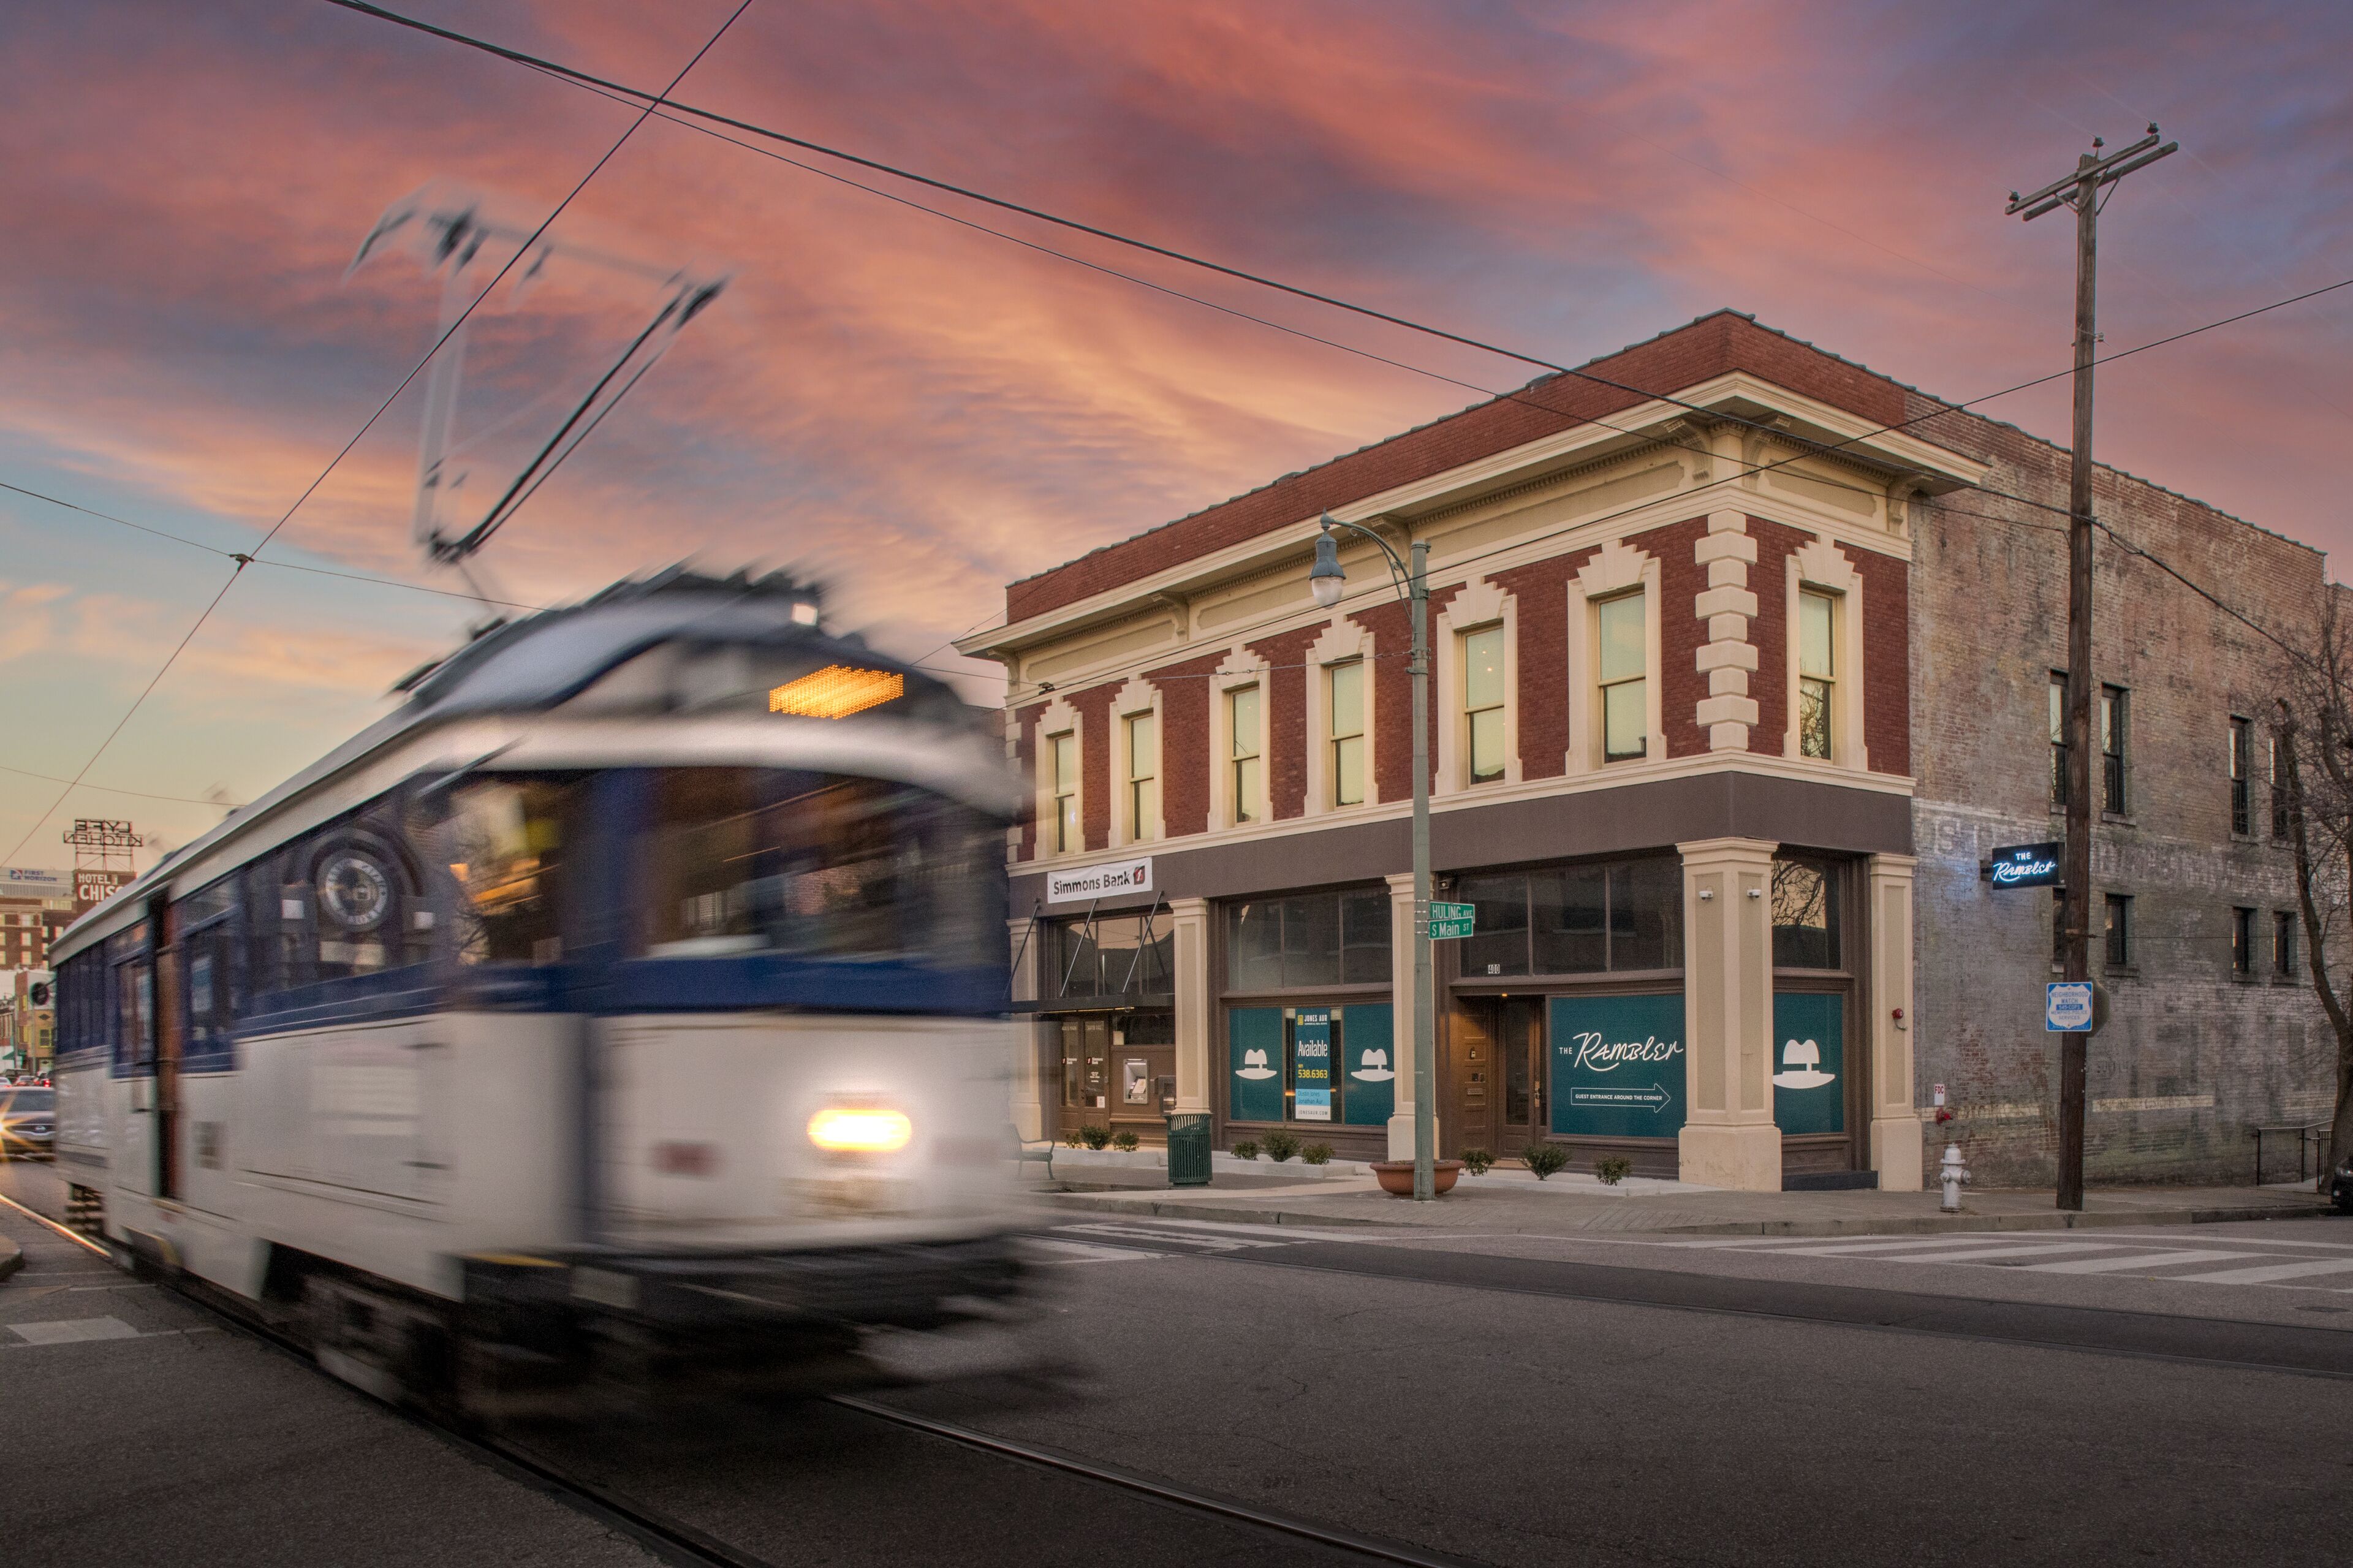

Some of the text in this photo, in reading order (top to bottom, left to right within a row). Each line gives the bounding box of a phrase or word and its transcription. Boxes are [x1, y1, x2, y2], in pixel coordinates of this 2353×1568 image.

[2015, 852, 2032, 860] THE
[78, 873, 111, 884] HOTEL
[1053, 871, 1131, 895] Simmons Bank
[79, 884, 125, 901] CHIS
[1432, 904, 1461, 918] HULING
[1432, 922, 1469, 937] S Main ST
[1489, 964, 1499, 973] 400
[1298, 1040, 1327, 1056] Available
[1298, 1069, 1328, 1078] 538.6363
[1934, 1086, 1944, 1094] FDC
